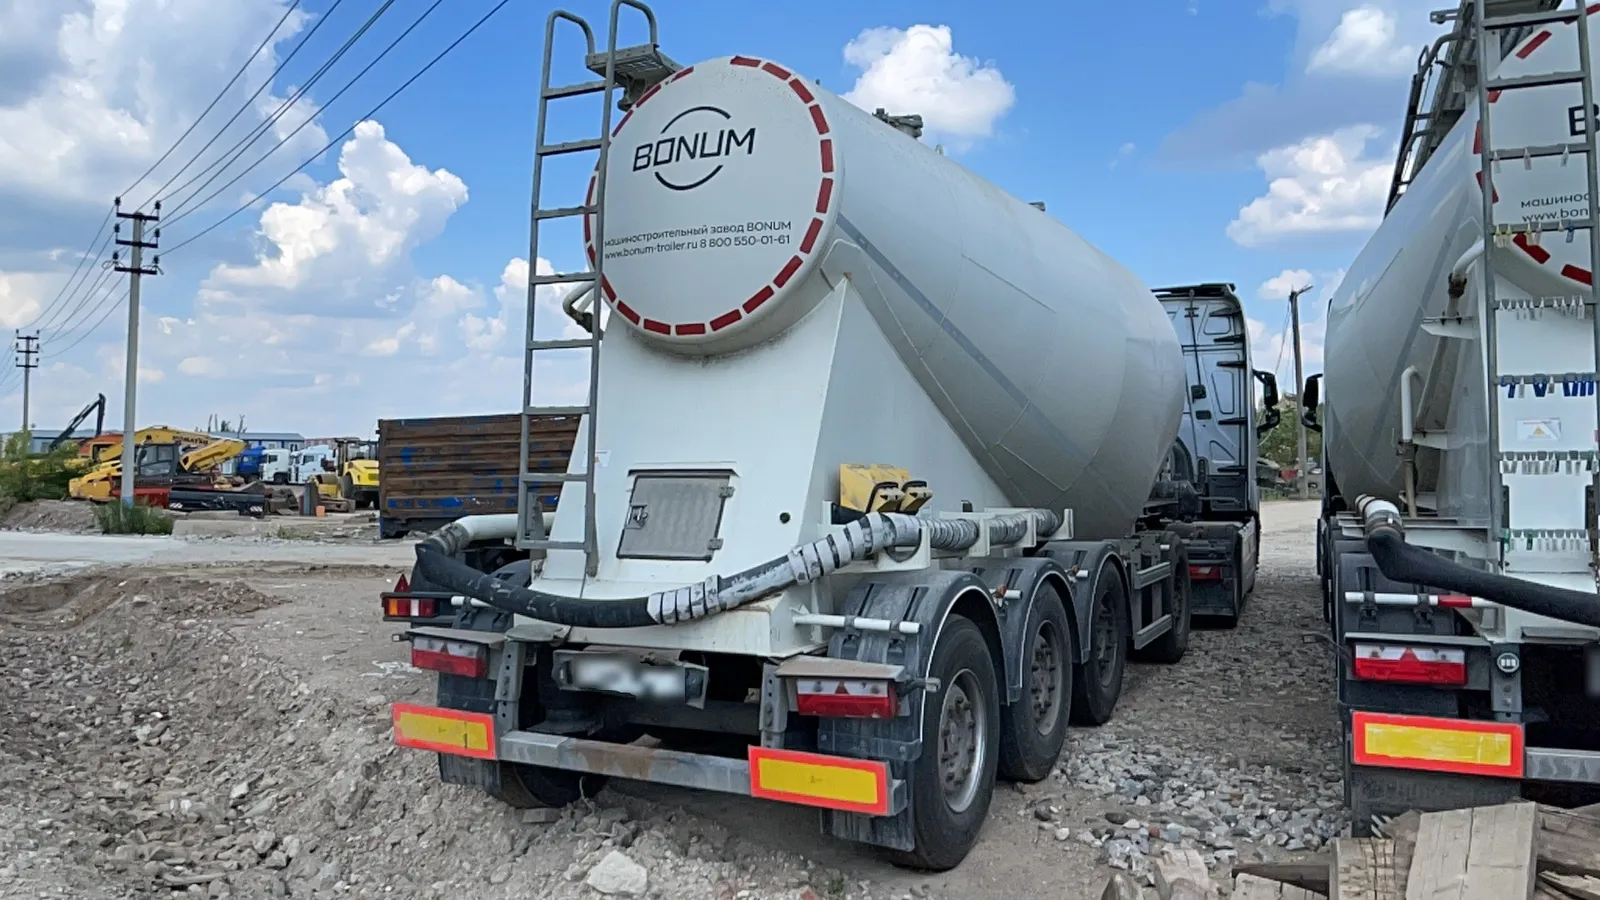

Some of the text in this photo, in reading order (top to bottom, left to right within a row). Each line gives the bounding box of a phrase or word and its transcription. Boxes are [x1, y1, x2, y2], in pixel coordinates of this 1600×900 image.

[633, 127, 756, 172] BONUM
[604, 221, 791, 247] машиностроительный завод BONUM
[604, 234, 790, 260] www.bonum-trailer.ru 8 800 550-01-61
